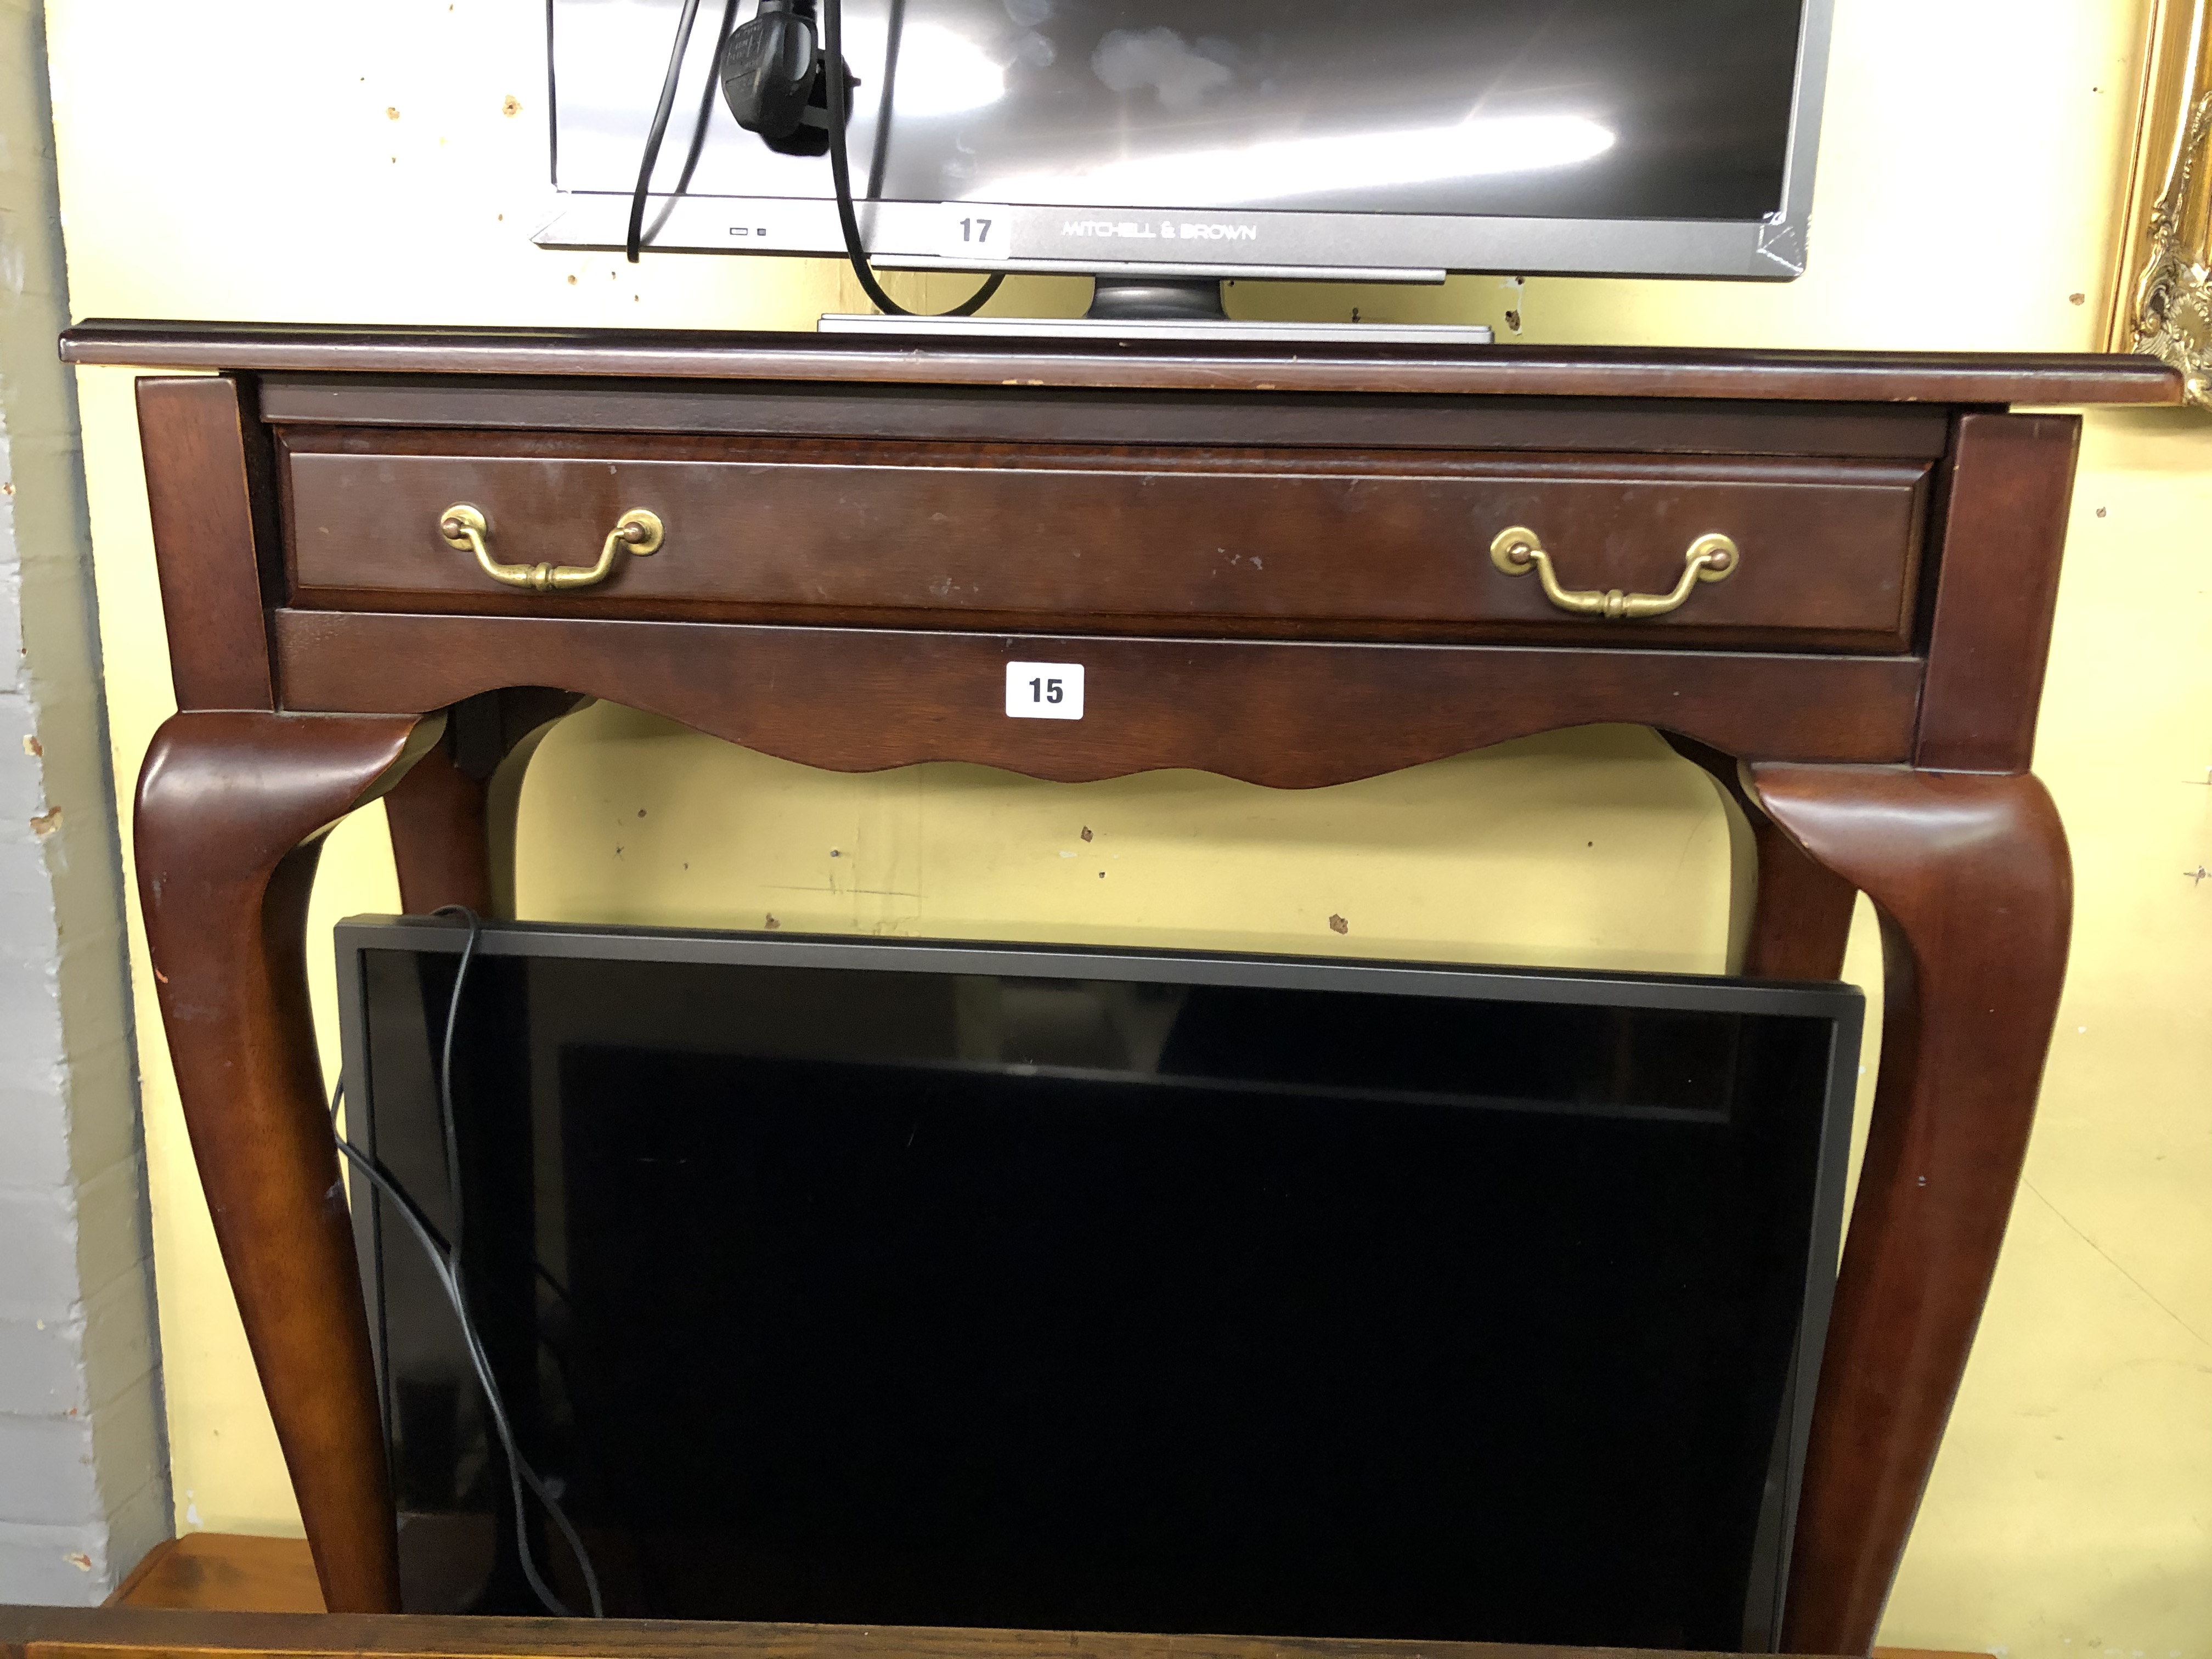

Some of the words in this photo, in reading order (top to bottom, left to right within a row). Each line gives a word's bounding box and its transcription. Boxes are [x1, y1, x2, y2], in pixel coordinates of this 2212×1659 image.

[960, 218, 992, 242] 17
[1063, 221, 1156, 238] MITCHELL
[1161, 221, 1175, 239] &
[1180, 223, 1257, 240] BROWN
[1029, 678, 1063, 703] 15
